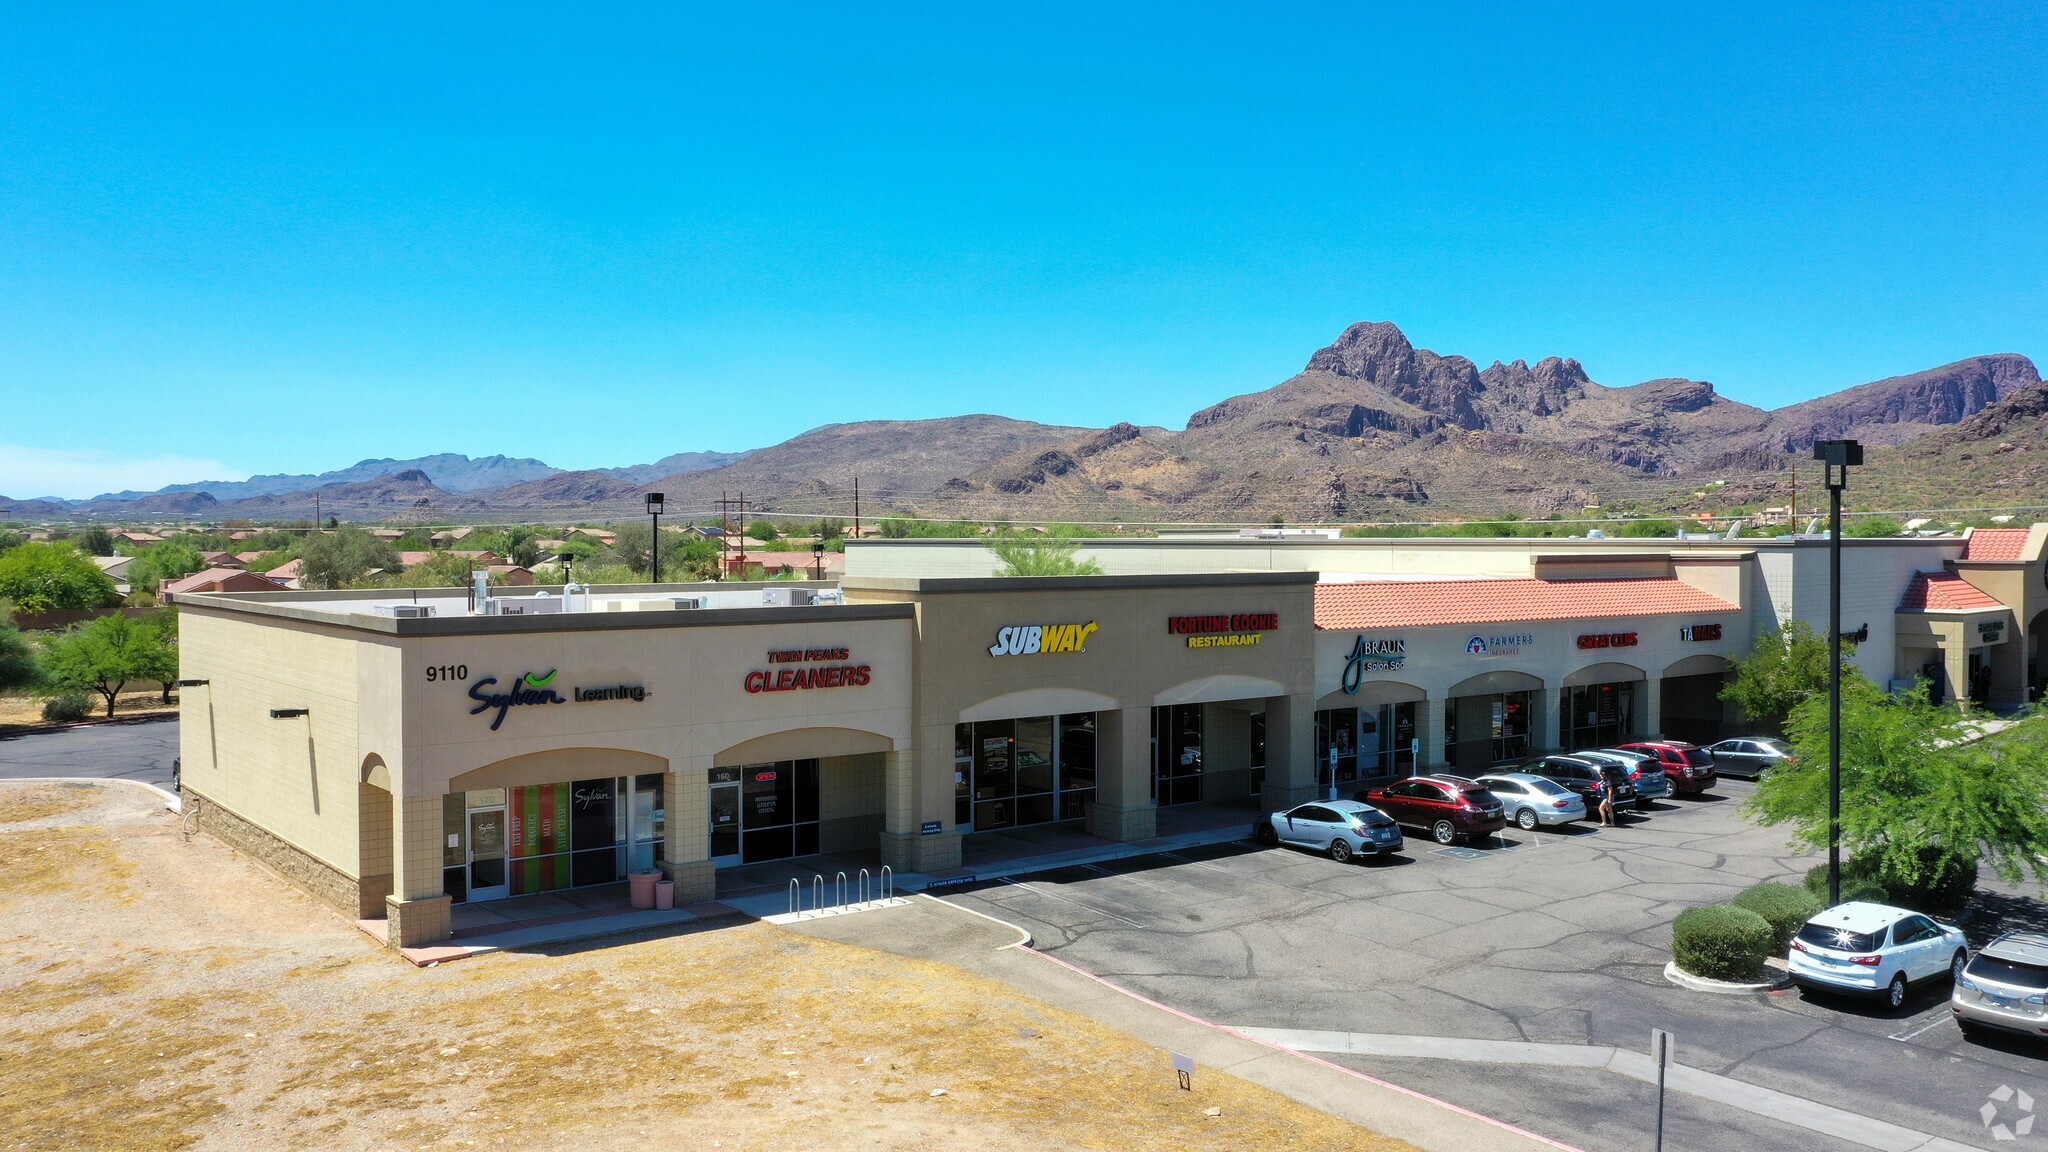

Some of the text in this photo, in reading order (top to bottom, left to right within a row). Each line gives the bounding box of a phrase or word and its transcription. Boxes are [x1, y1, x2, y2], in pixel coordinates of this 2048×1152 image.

[1168, 613, 1279, 634] FORTUNE COOKIE
[988, 620, 1099, 658] SUBWAY
[1186, 633, 1262, 648] RESTAURANT
[1489, 635, 1533, 647] FARMERS
[1576, 632, 1639, 650] GREAT CLIPS
[1680, 624, 1722, 642] TA NAILS
[768, 648, 850, 663] TWIN PEAKS
[425, 664, 469, 682] 9110
[1365, 661, 1406, 672] Salon Spa
[745, 664, 871, 693] CLEANERS
[468, 677, 645, 731] Sylvan Learning
[716, 772, 730, 781] 160
[756, 772, 776, 781] OPEN
[481, 796, 495, 805] 170
[574, 788, 612, 810] Sylvan
[557, 803, 567, 830] CLASSES
[528, 813, 536, 847] ROBOTICS
[542, 818, 551, 837] MATH
